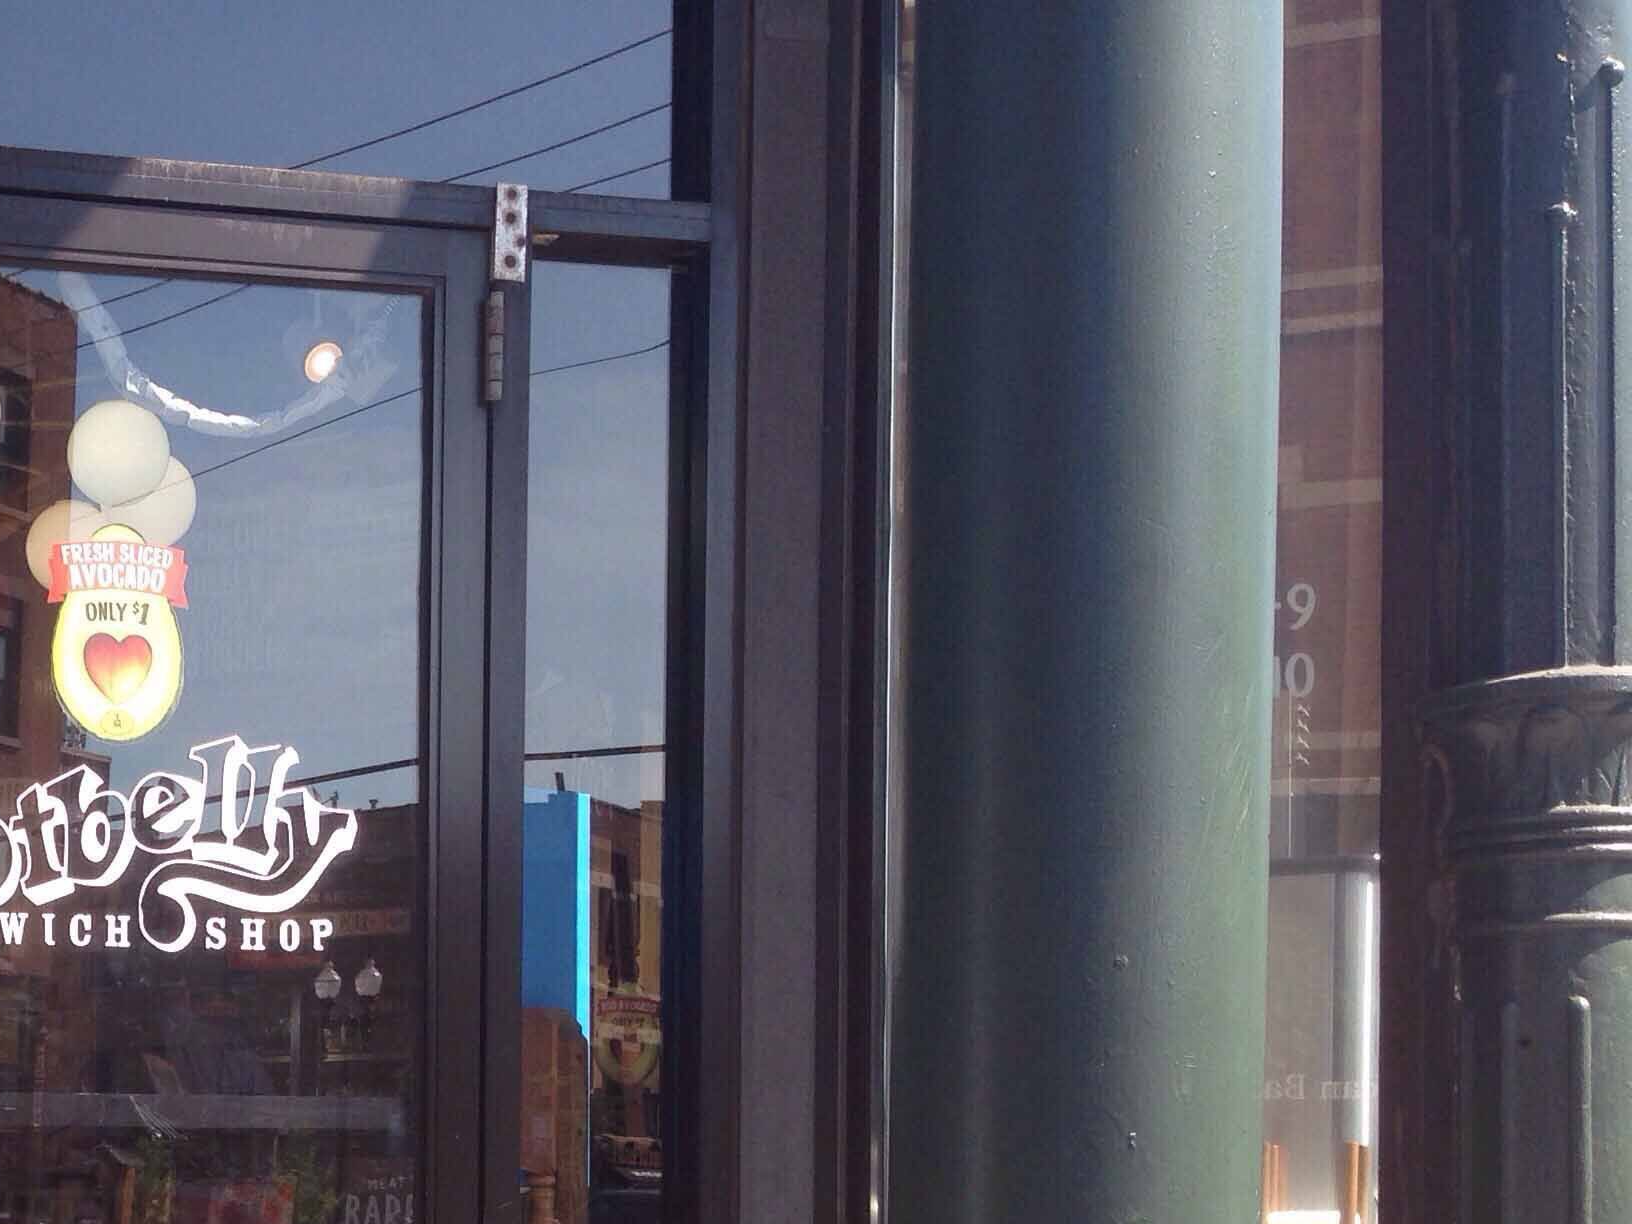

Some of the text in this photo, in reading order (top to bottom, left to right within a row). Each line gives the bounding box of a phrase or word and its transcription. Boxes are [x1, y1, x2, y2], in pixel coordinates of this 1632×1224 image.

[60, 544, 173, 568] FRESH SLICED
[68, 563, 166, 592] AVOCADO
[85, 601, 150, 625] ONLY $1
[205, 917, 337, 952] SHOP
